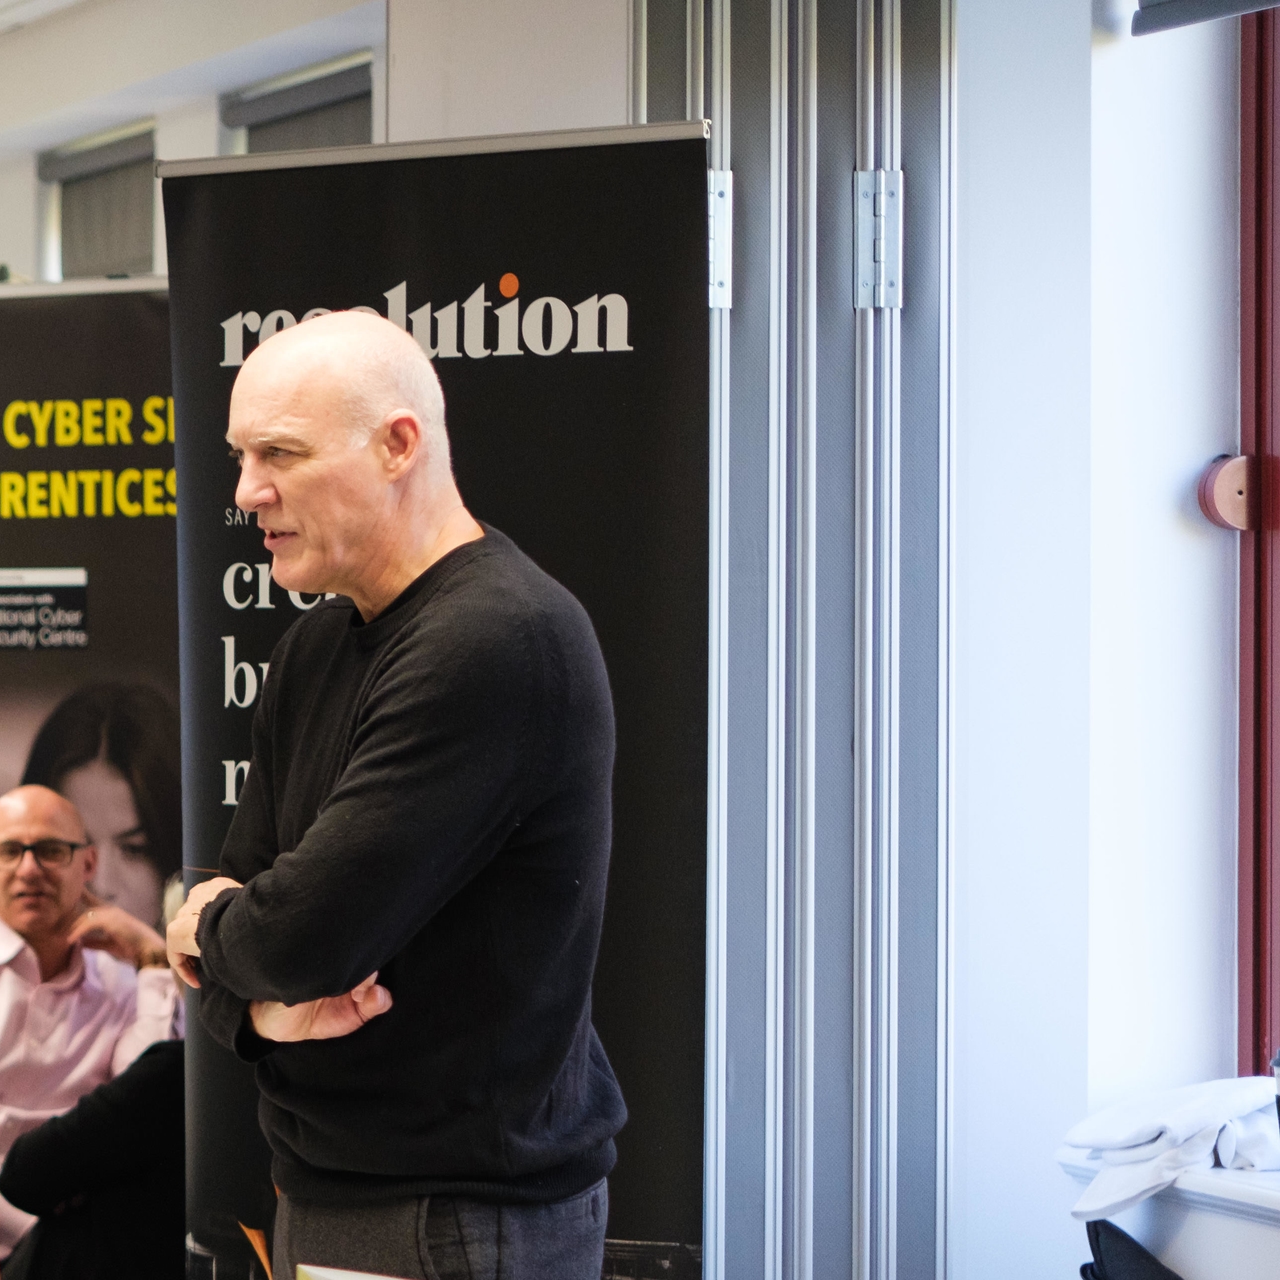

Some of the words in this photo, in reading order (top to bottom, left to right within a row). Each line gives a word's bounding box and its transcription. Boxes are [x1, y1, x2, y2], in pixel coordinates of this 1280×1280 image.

[219, 272, 634, 368] relution
[3, 397, 133, 449] CYBER
[142, 395, 176, 446] S
[225, 507, 251, 526] SAY
